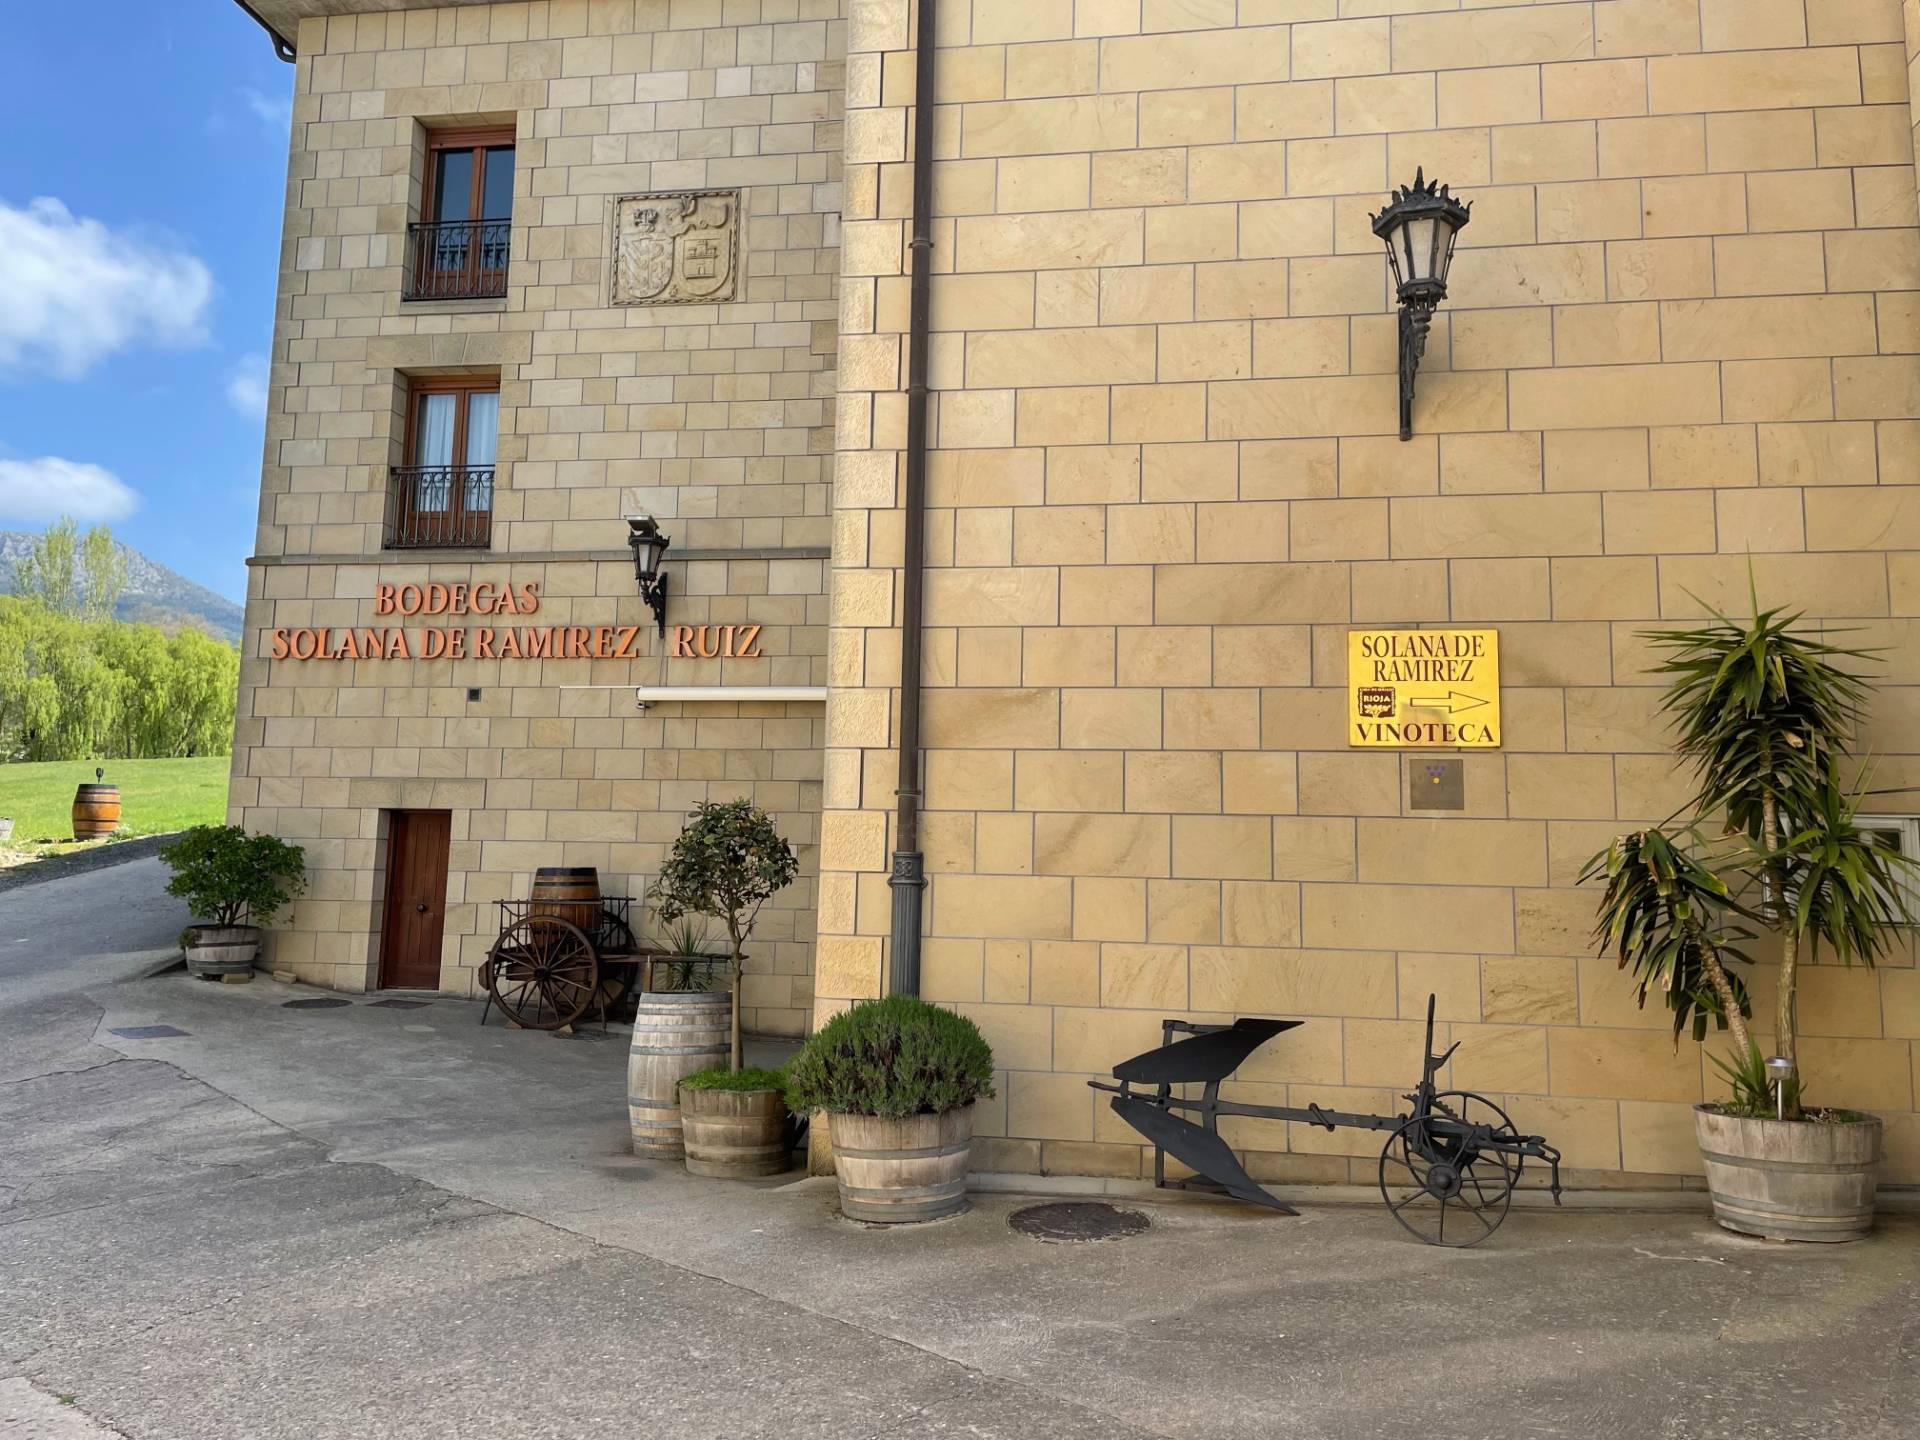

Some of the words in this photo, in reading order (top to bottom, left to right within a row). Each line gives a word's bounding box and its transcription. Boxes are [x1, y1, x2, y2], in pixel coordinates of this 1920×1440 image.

[375, 582, 539, 616] BODEGAS
[271, 628, 411, 660] SOLANA
[419, 628, 465, 660] DE
[472, 625, 640, 659] RAMIREZ
[672, 624, 762, 658] RUIZ
[1362, 635, 1449, 657] SOLANA
[1454, 635, 1485, 657] DE
[1373, 659, 1474, 682] RAMIREZ
[1363, 694, 1391, 703] RIOJA
[1356, 723, 1494, 743] VINOTECA
